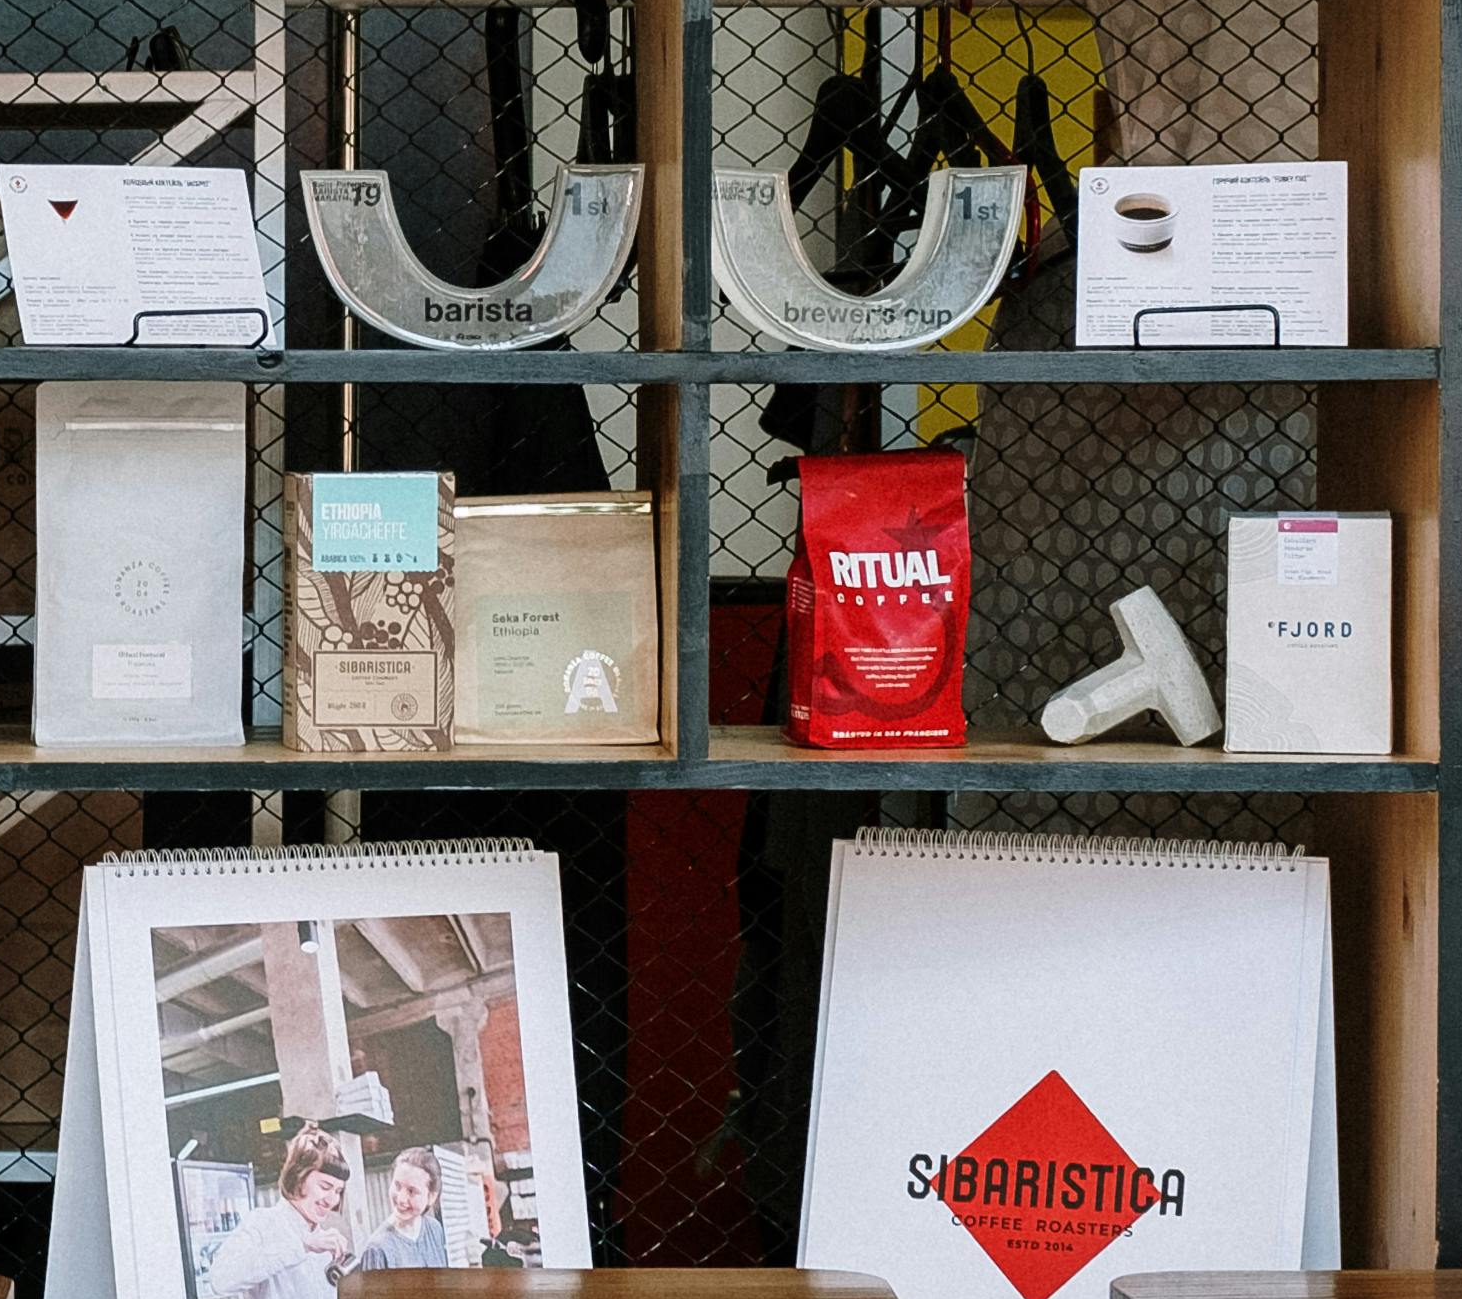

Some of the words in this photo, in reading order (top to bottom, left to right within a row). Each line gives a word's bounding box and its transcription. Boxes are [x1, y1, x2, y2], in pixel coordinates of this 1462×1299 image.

[565, 182, 608, 218] 1st
[955, 185, 1000, 222] 1st
[424, 297, 533, 325] barista
[783, 301, 896, 325] brewer's
[904, 304, 953, 329] cup
[322, 502, 382, 520] ETHIOPIA
[322, 522, 407, 542] YIRGACHEFFE
[829, 550, 951, 589] RITUAL
[837, 591, 953, 606] COFFEE
[523, 612, 560, 622] Forest
[493, 626, 539, 636] Ethiopia
[1277, 620, 1353, 639] FJORD
[339, 660, 412, 675] SIBARISTICA
[907, 1152, 1186, 1218] SIBARISTICA
[950, 1213, 1024, 1232] COFFEE
[1035, 1218, 1134, 1239] ROASTERS
[1006, 1239, 1040, 1251] ESTD
[1044, 1240, 1074, 1253] 2014
